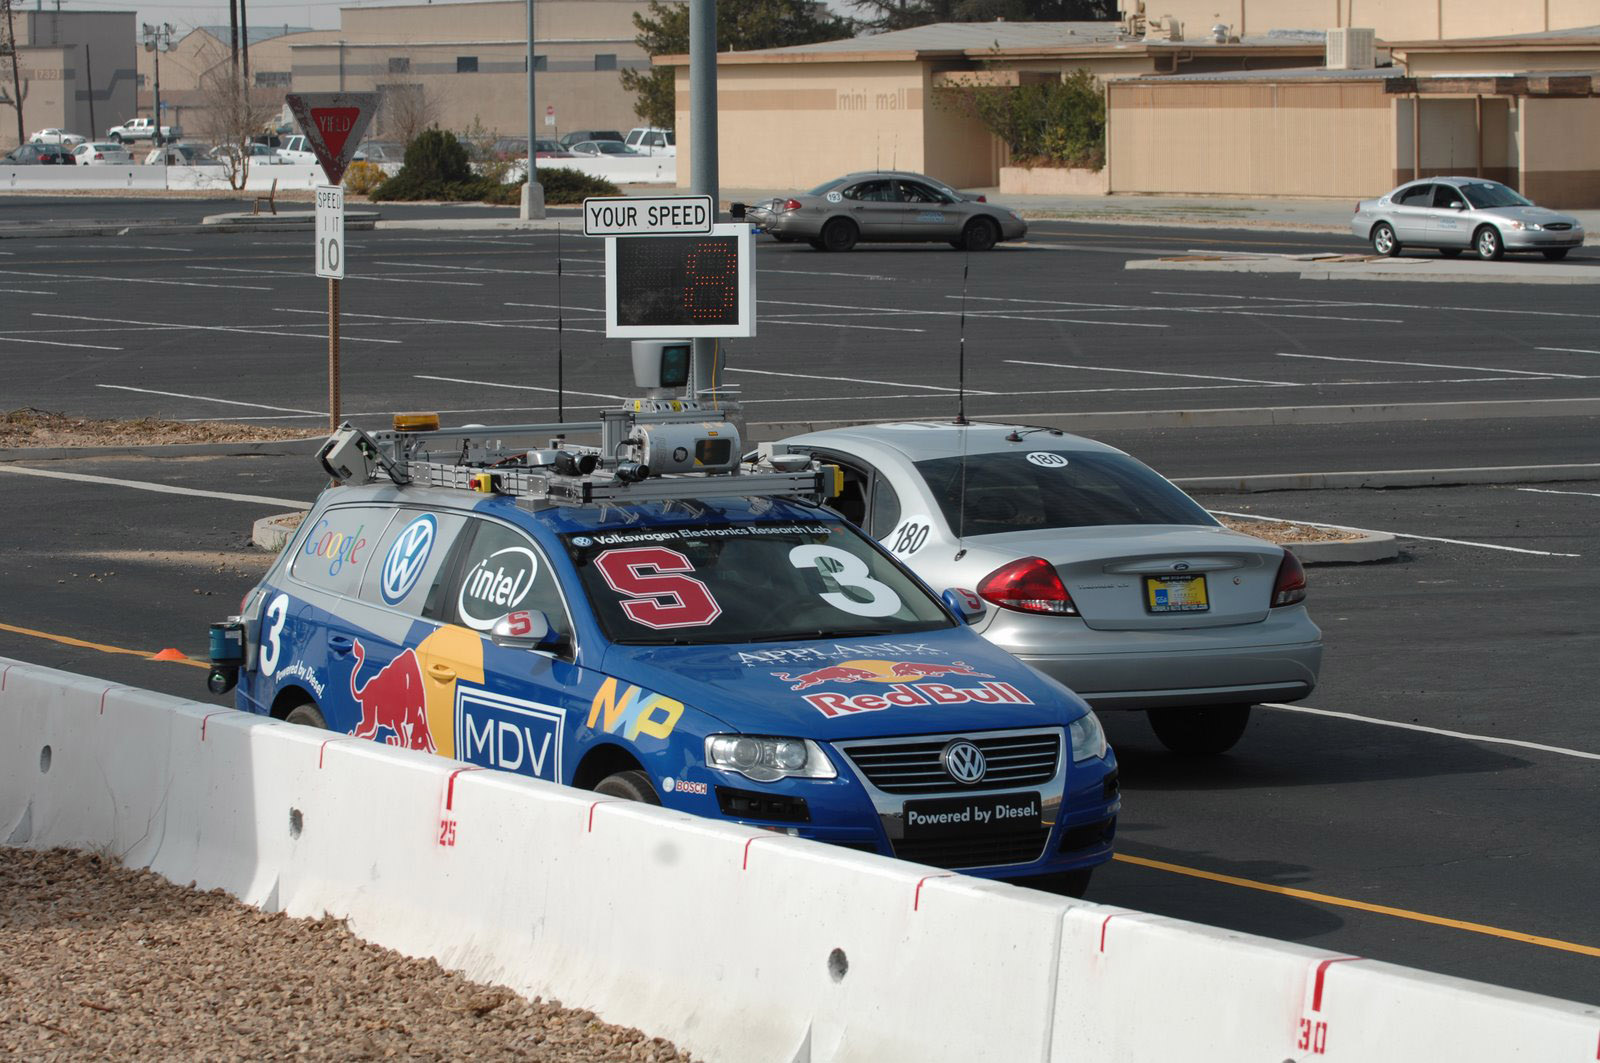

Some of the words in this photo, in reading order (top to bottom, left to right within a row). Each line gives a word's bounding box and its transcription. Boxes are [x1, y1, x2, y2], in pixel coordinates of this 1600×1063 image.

[839, 88, 867, 110] mini
[876, 88, 905, 110] mall
[320, 116, 350, 132] YIELD
[318, 192, 341, 209] SPEED
[828, 192, 841, 201] 193
[591, 206, 637, 227] YOUR
[648, 205, 706, 226] SPEED
[319, 237, 340, 272] 10
[683, 242, 737, 319] 8
[1030, 454, 1064, 465] 180
[305, 519, 366, 577] Google
[593, 531, 681, 545] Volkswagen
[678, 526, 749, 538] Electronics
[747, 525, 809, 535] Research
[804, 525, 832, 534] Lab
[891, 521, 930, 554] 180
[469, 558, 526, 608] intel
[593, 546, 722, 629] S
[789, 544, 901, 617] 3
[260, 593, 289, 677] 3
[507, 611, 532, 636] S
[275, 660, 300, 685] Powered
[298, 660, 307, 680] by
[586, 677, 685, 742] NXP
[801, 684, 931, 719] Red
[912, 681, 1036, 706] Bull
[466, 713, 552, 777] MDV
[675, 780, 708, 795] BOSCH
[908, 806, 971, 826] Powered
[974, 805, 992, 825] by
[995, 801, 1039, 820] Diesel.
[439, 820, 457, 847] 25
[1298, 1018, 1328, 1055] 30
